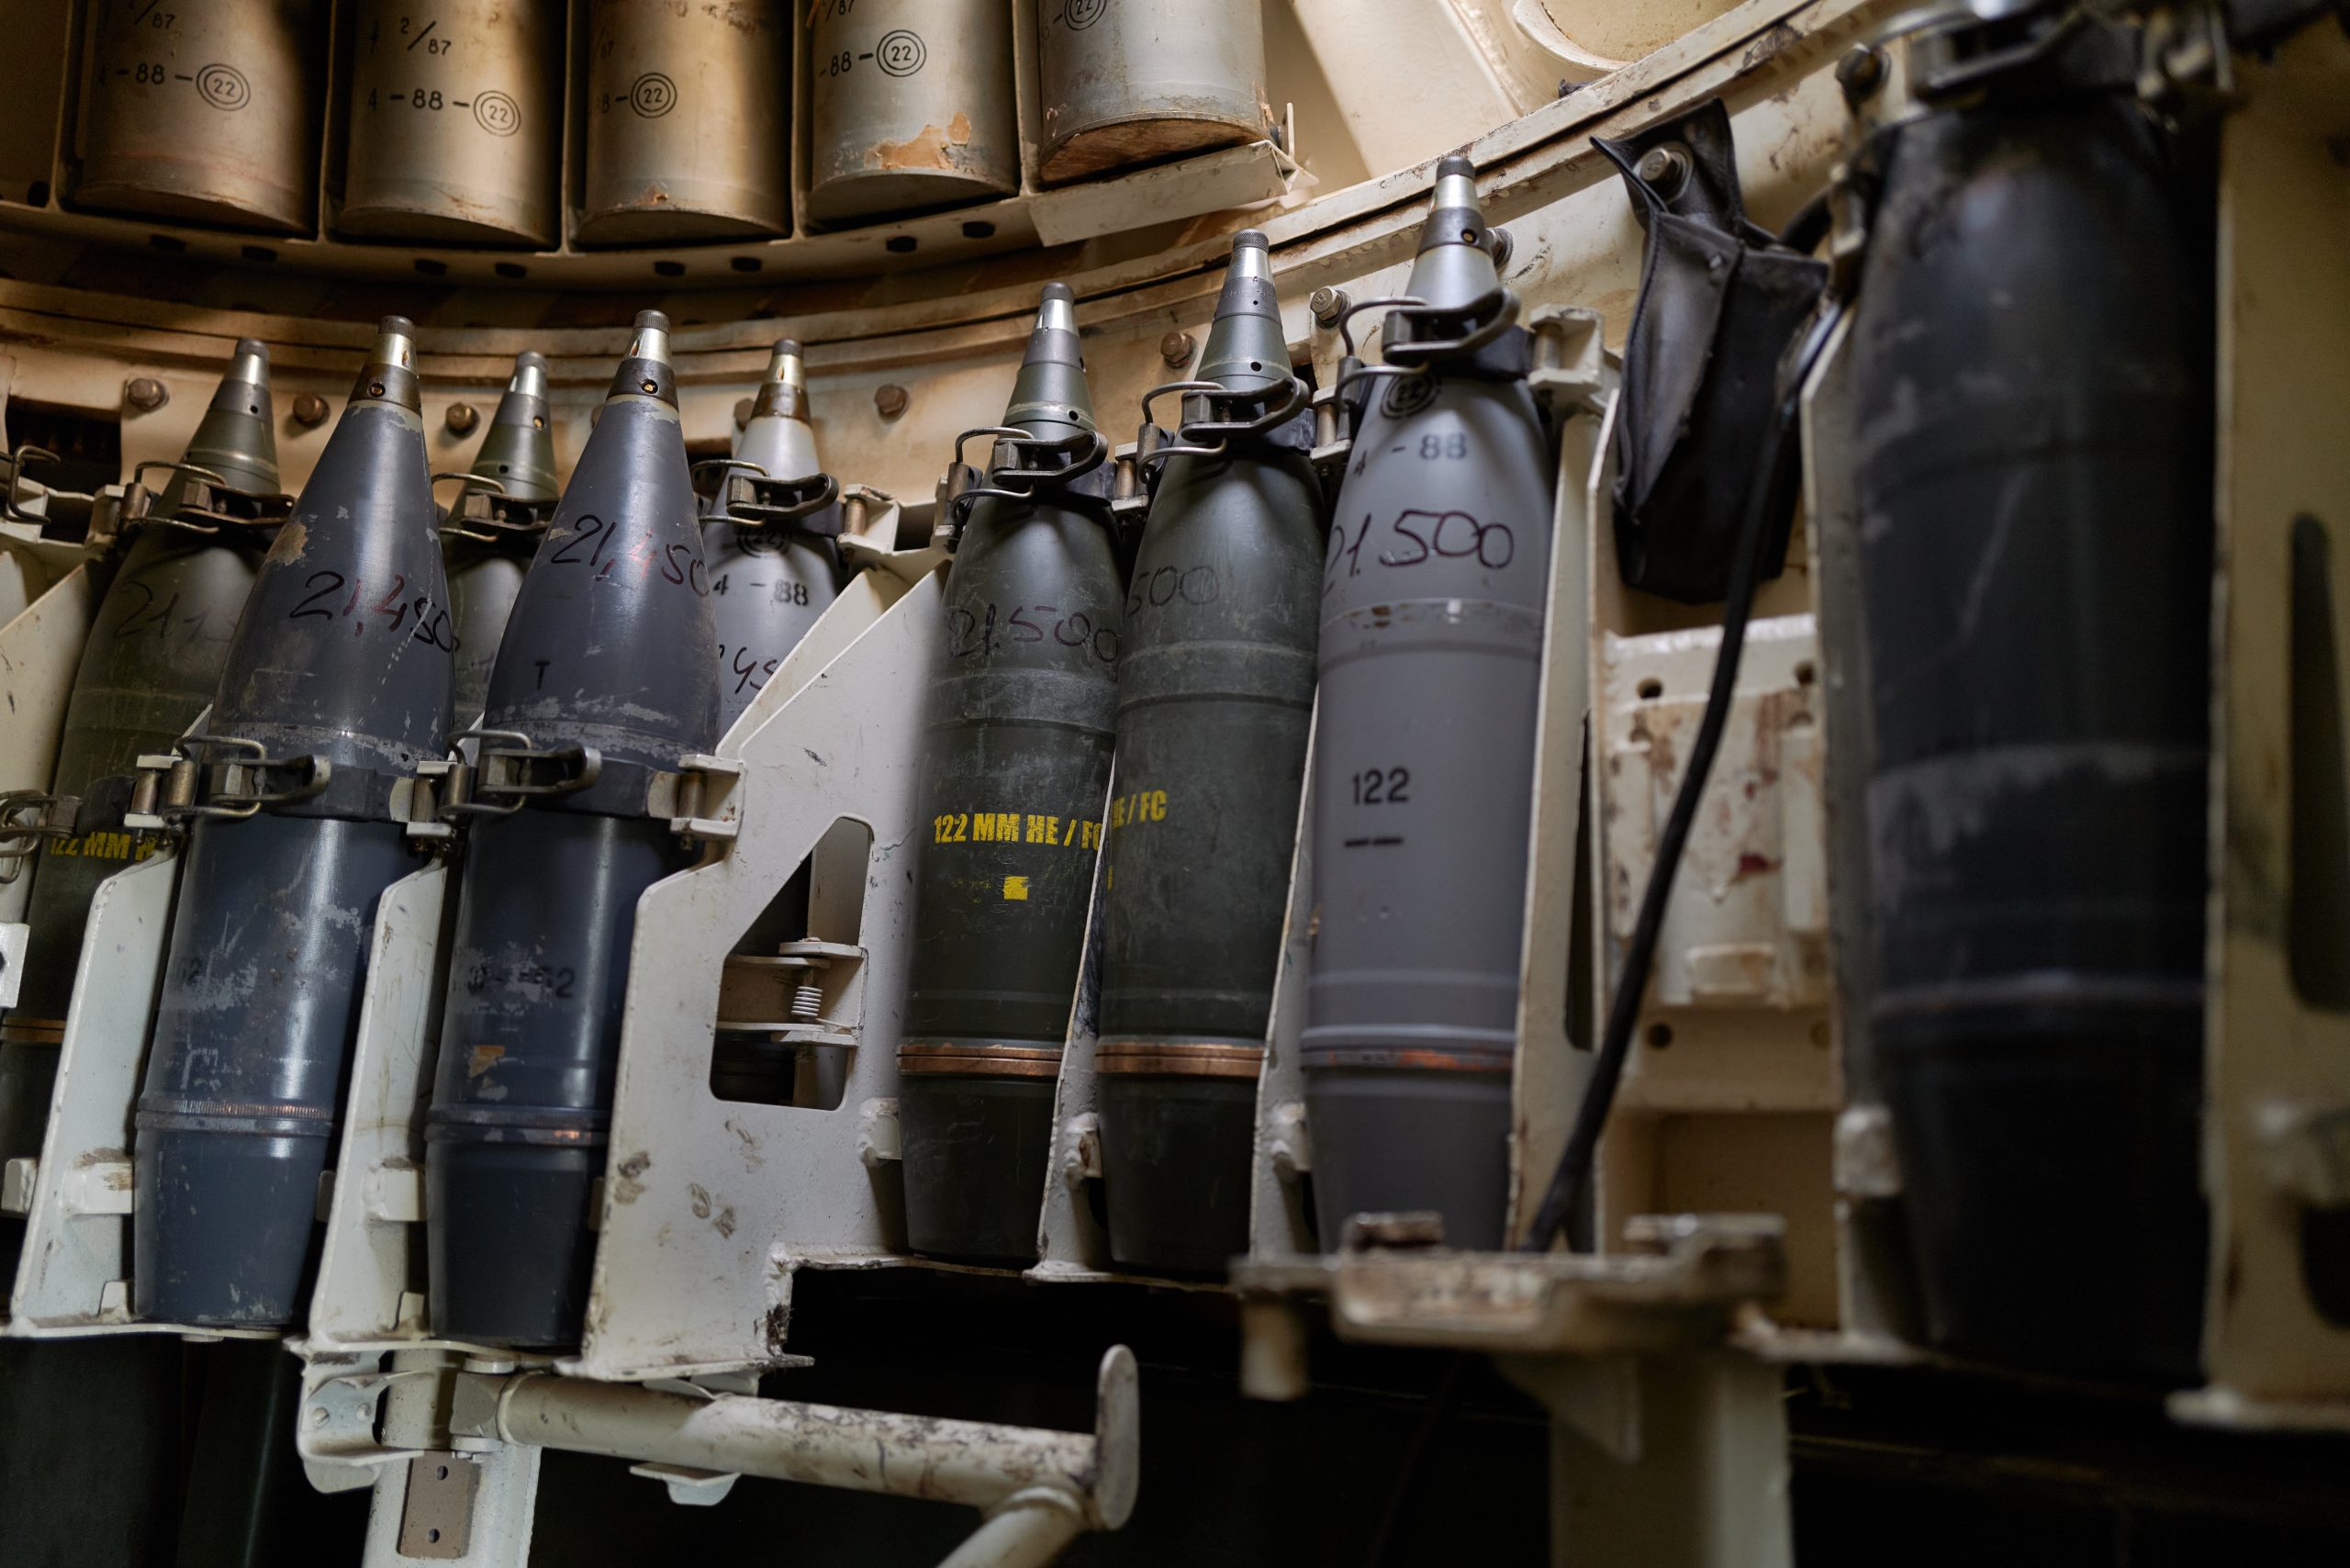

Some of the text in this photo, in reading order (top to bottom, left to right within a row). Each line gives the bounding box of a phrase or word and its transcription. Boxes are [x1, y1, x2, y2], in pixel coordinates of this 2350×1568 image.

[890, 45, 912, 62] 22
[212, 78, 236, 97] 22
[643, 87, 663, 104] 22
[487, 105, 509, 124] 22
[1352, 767, 1410, 806] 122
[1138, 790, 1169, 823] FC
[934, 813, 969, 845] 122
[973, 813, 1021, 843] MM
[1025, 814, 1059, 846] HE
